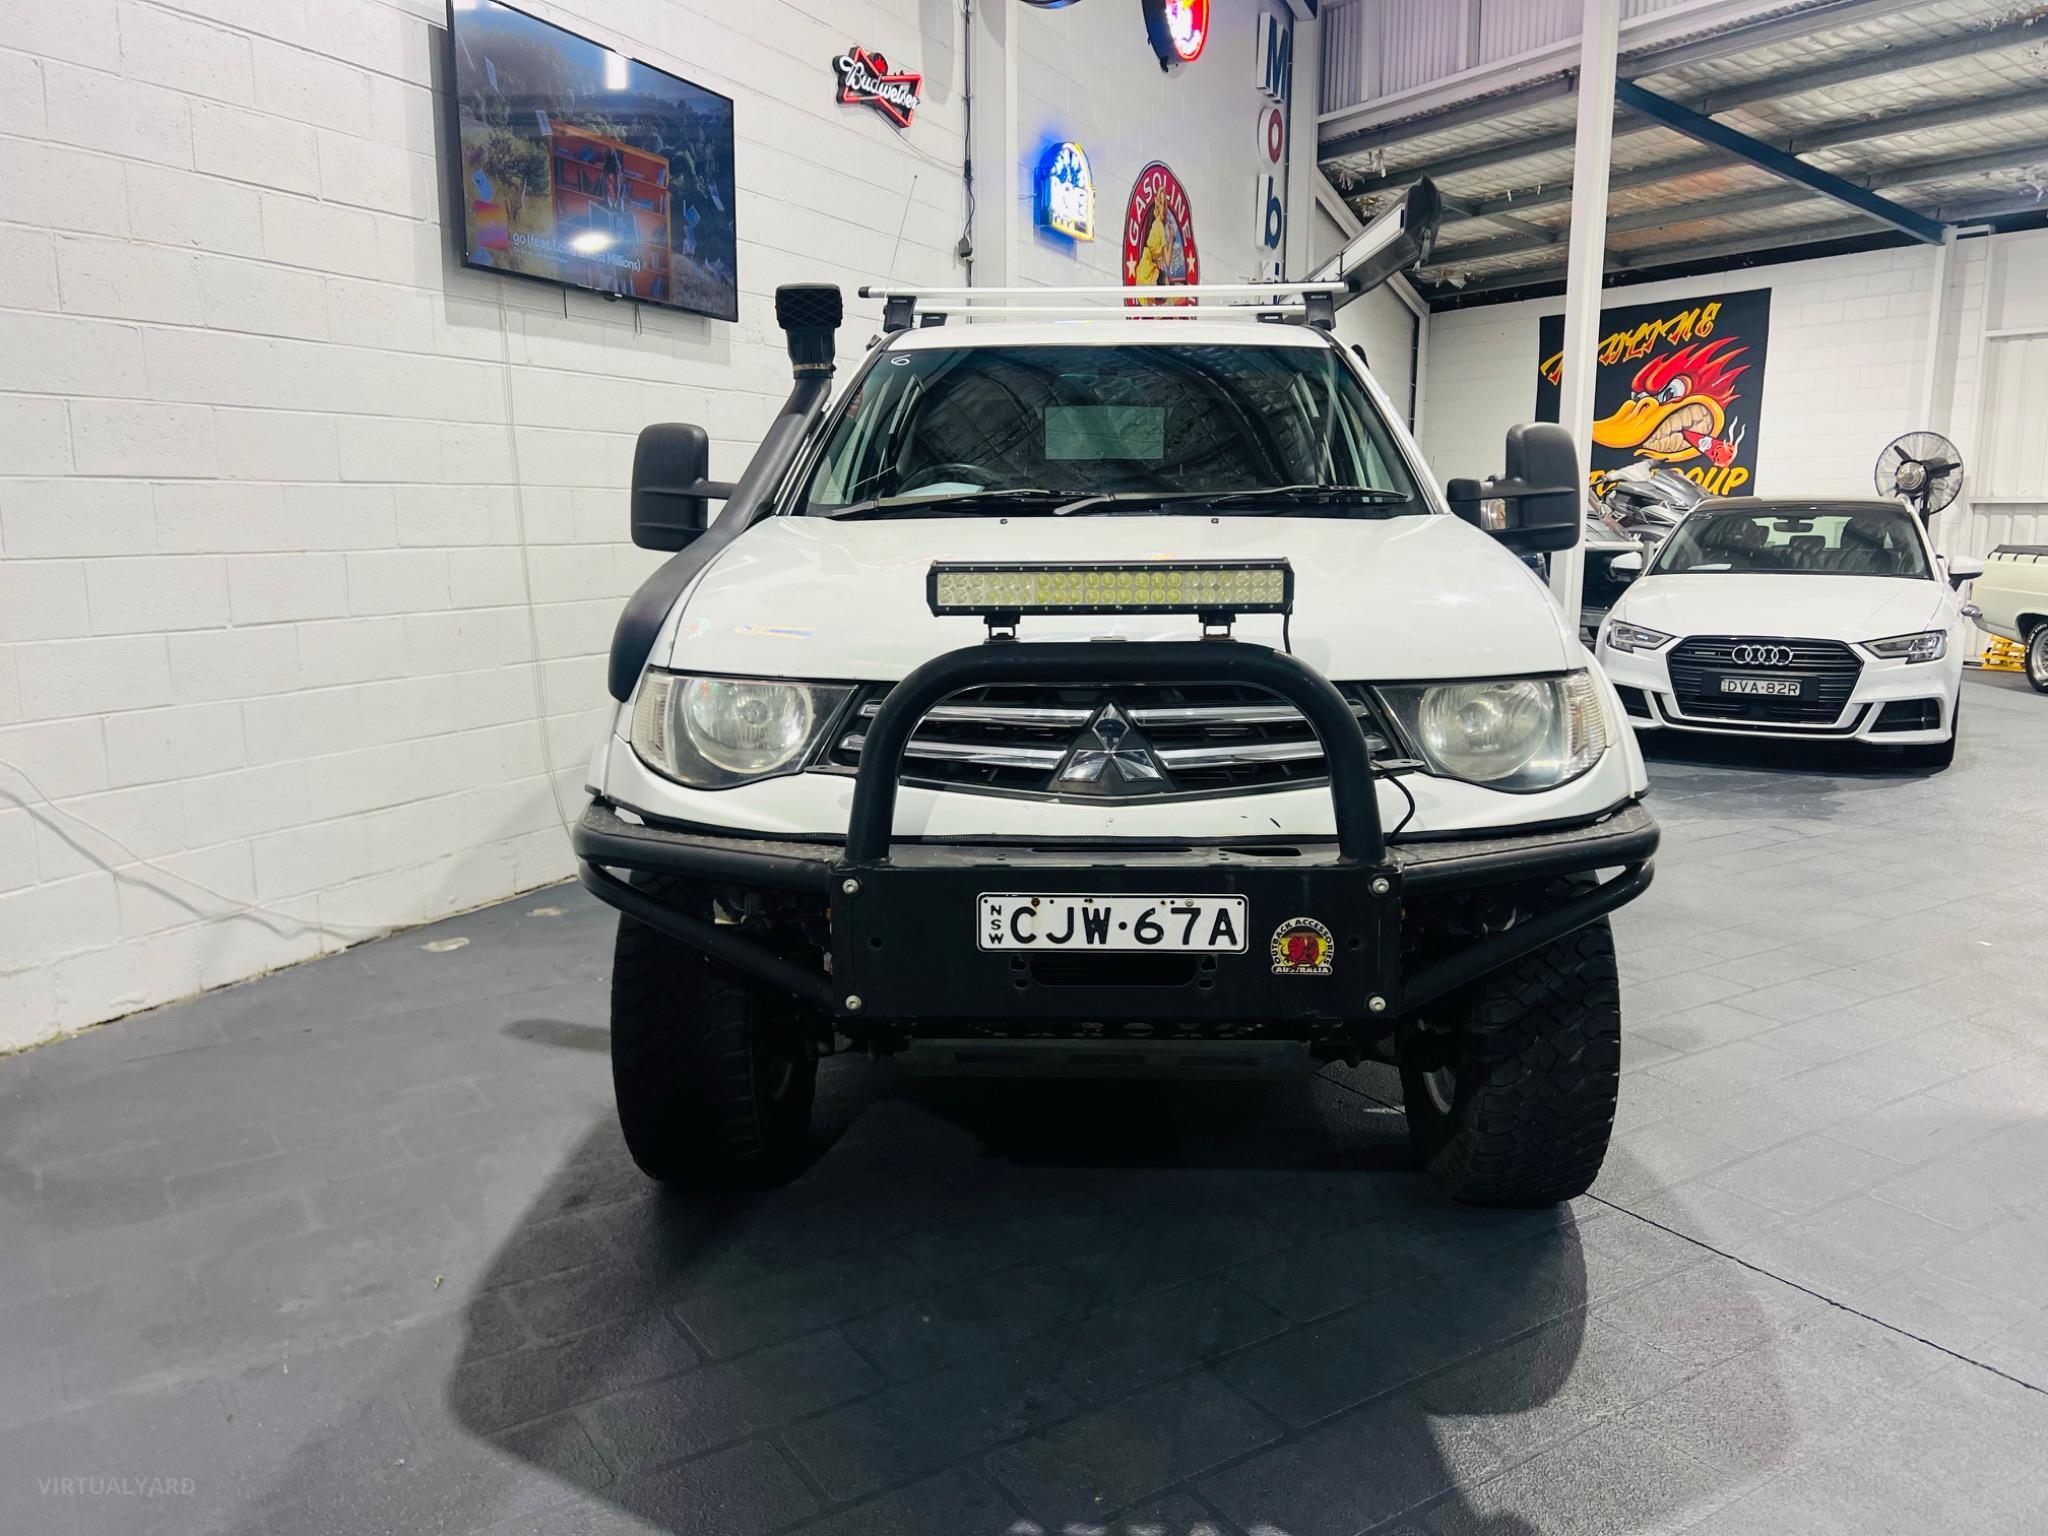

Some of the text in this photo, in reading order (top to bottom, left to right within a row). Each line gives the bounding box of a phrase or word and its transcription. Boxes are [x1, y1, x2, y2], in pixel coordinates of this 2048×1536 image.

[839, 56, 917, 109] Budweiser
[1129, 172, 1191, 247] GASOLINE
[1271, 918, 1334, 965] OUTBACK ACCESSORIES
